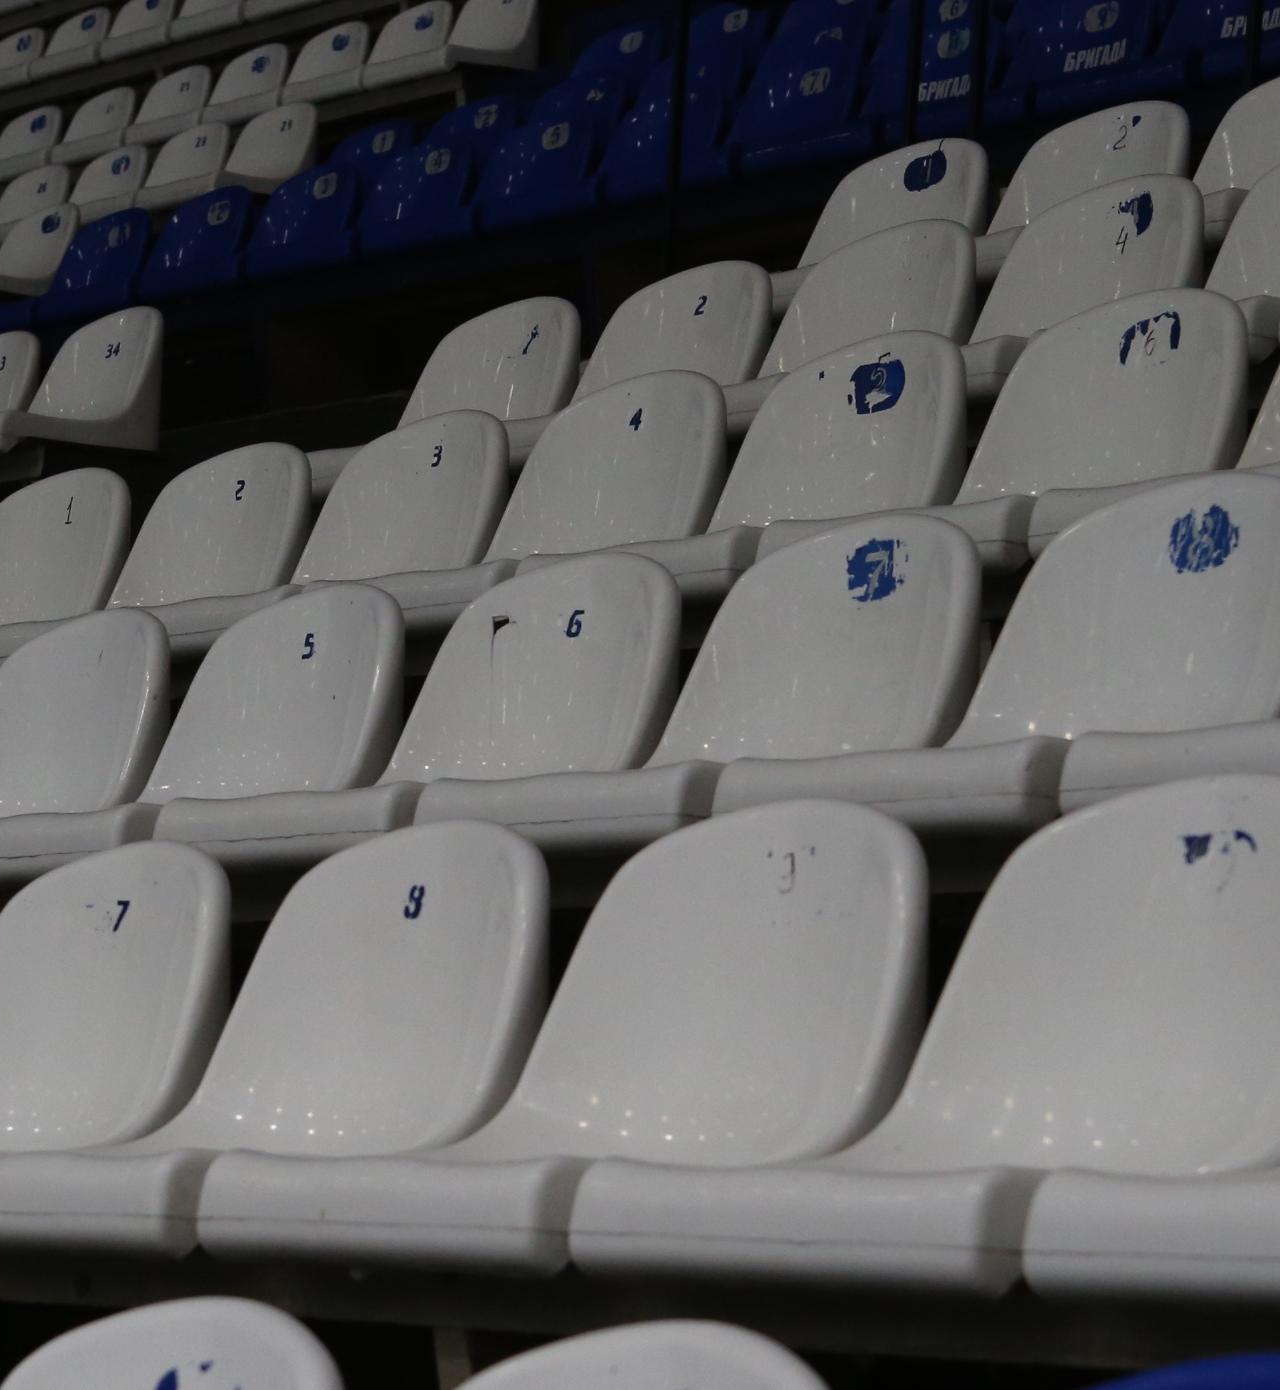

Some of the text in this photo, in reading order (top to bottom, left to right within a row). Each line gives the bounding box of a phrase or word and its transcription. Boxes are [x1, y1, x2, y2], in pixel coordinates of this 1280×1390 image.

[1112, 124, 1128, 151] 2
[1115, 226, 1129, 254] 4
[693, 295, 708, 316] 2
[104, 341, 121, 359] 34
[628, 407, 643, 432] 4
[430, 445, 443, 468] 3
[235, 479, 246, 502] 2
[64, 496, 74, 525] 1
[565, 609, 585, 638] 6
[301, 632, 315, 660] 5
[114, 900, 131, 933] 7
